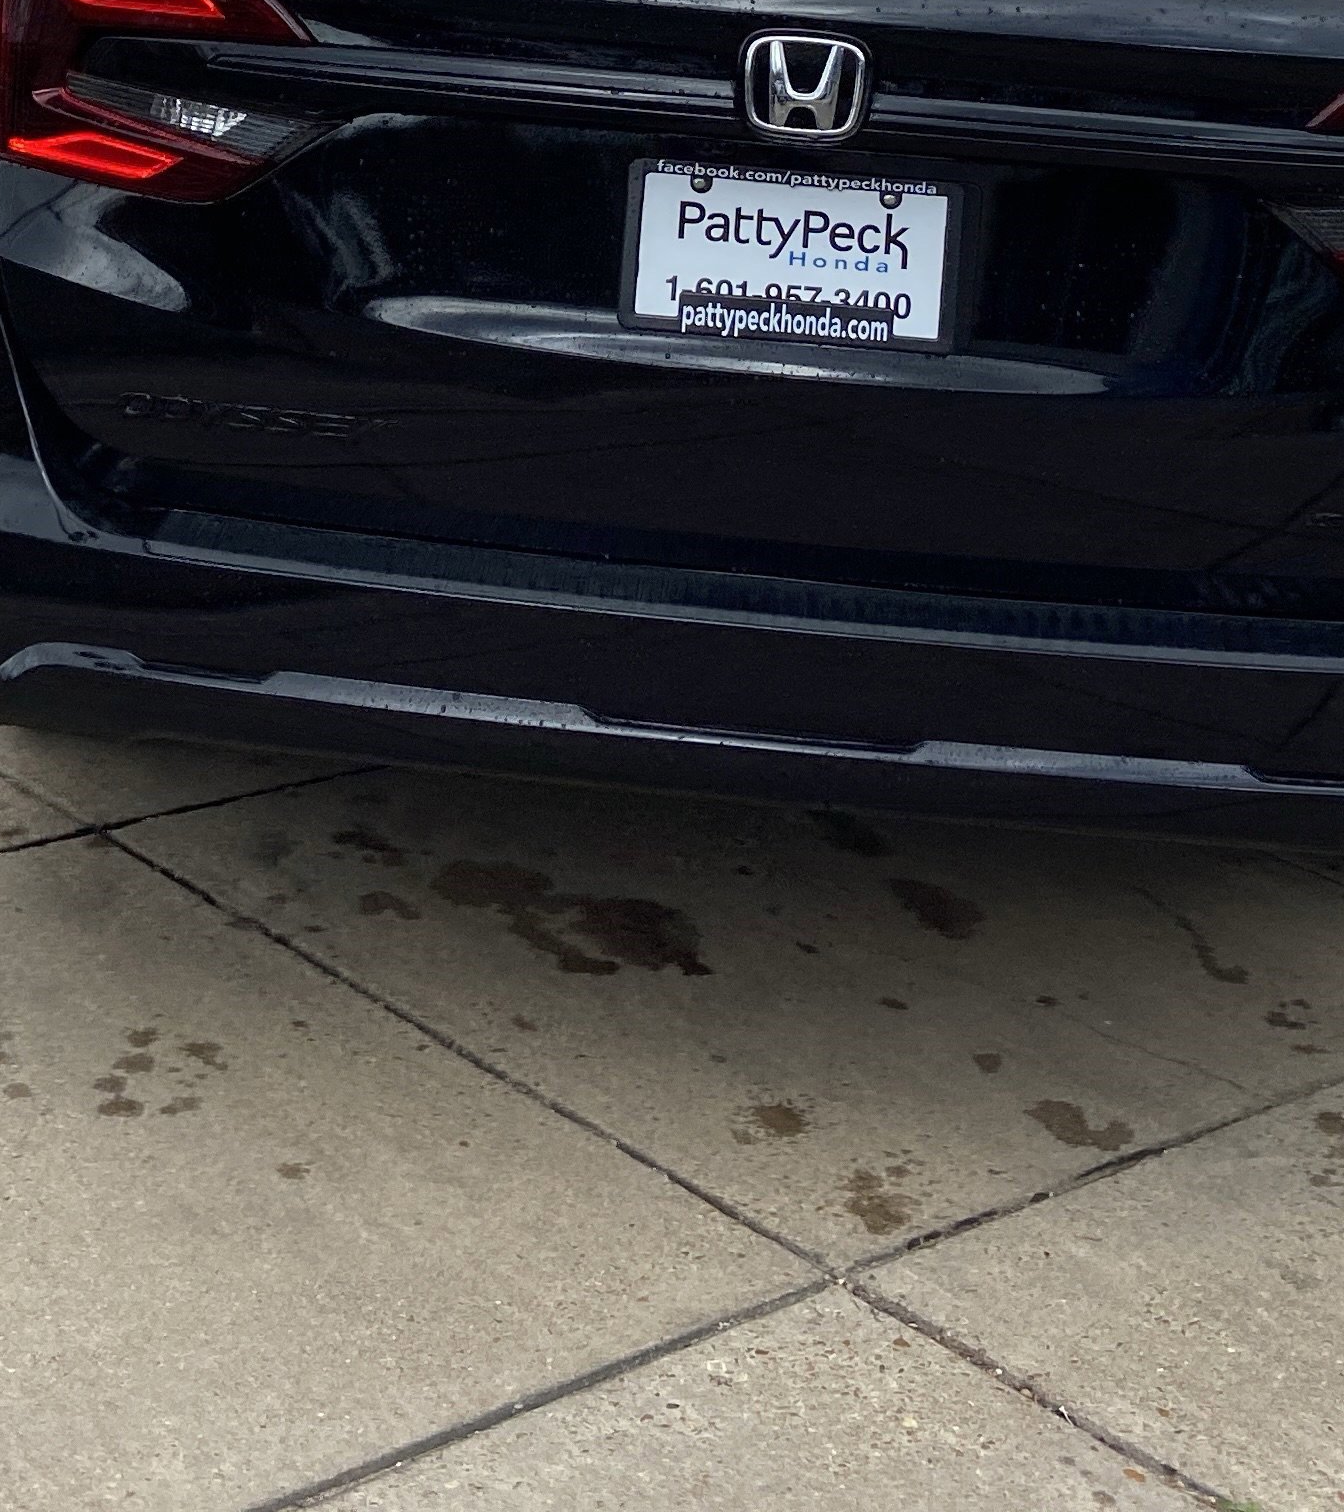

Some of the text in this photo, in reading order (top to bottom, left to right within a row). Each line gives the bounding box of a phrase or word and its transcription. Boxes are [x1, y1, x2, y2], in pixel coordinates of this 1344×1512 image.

[657, 159, 937, 195] facebook.com/pattypeckhonda
[677, 200, 910, 270] PattyPeck
[788, 251, 889, 273] Honda
[680, 301, 889, 342] pattypeckhonda.com
